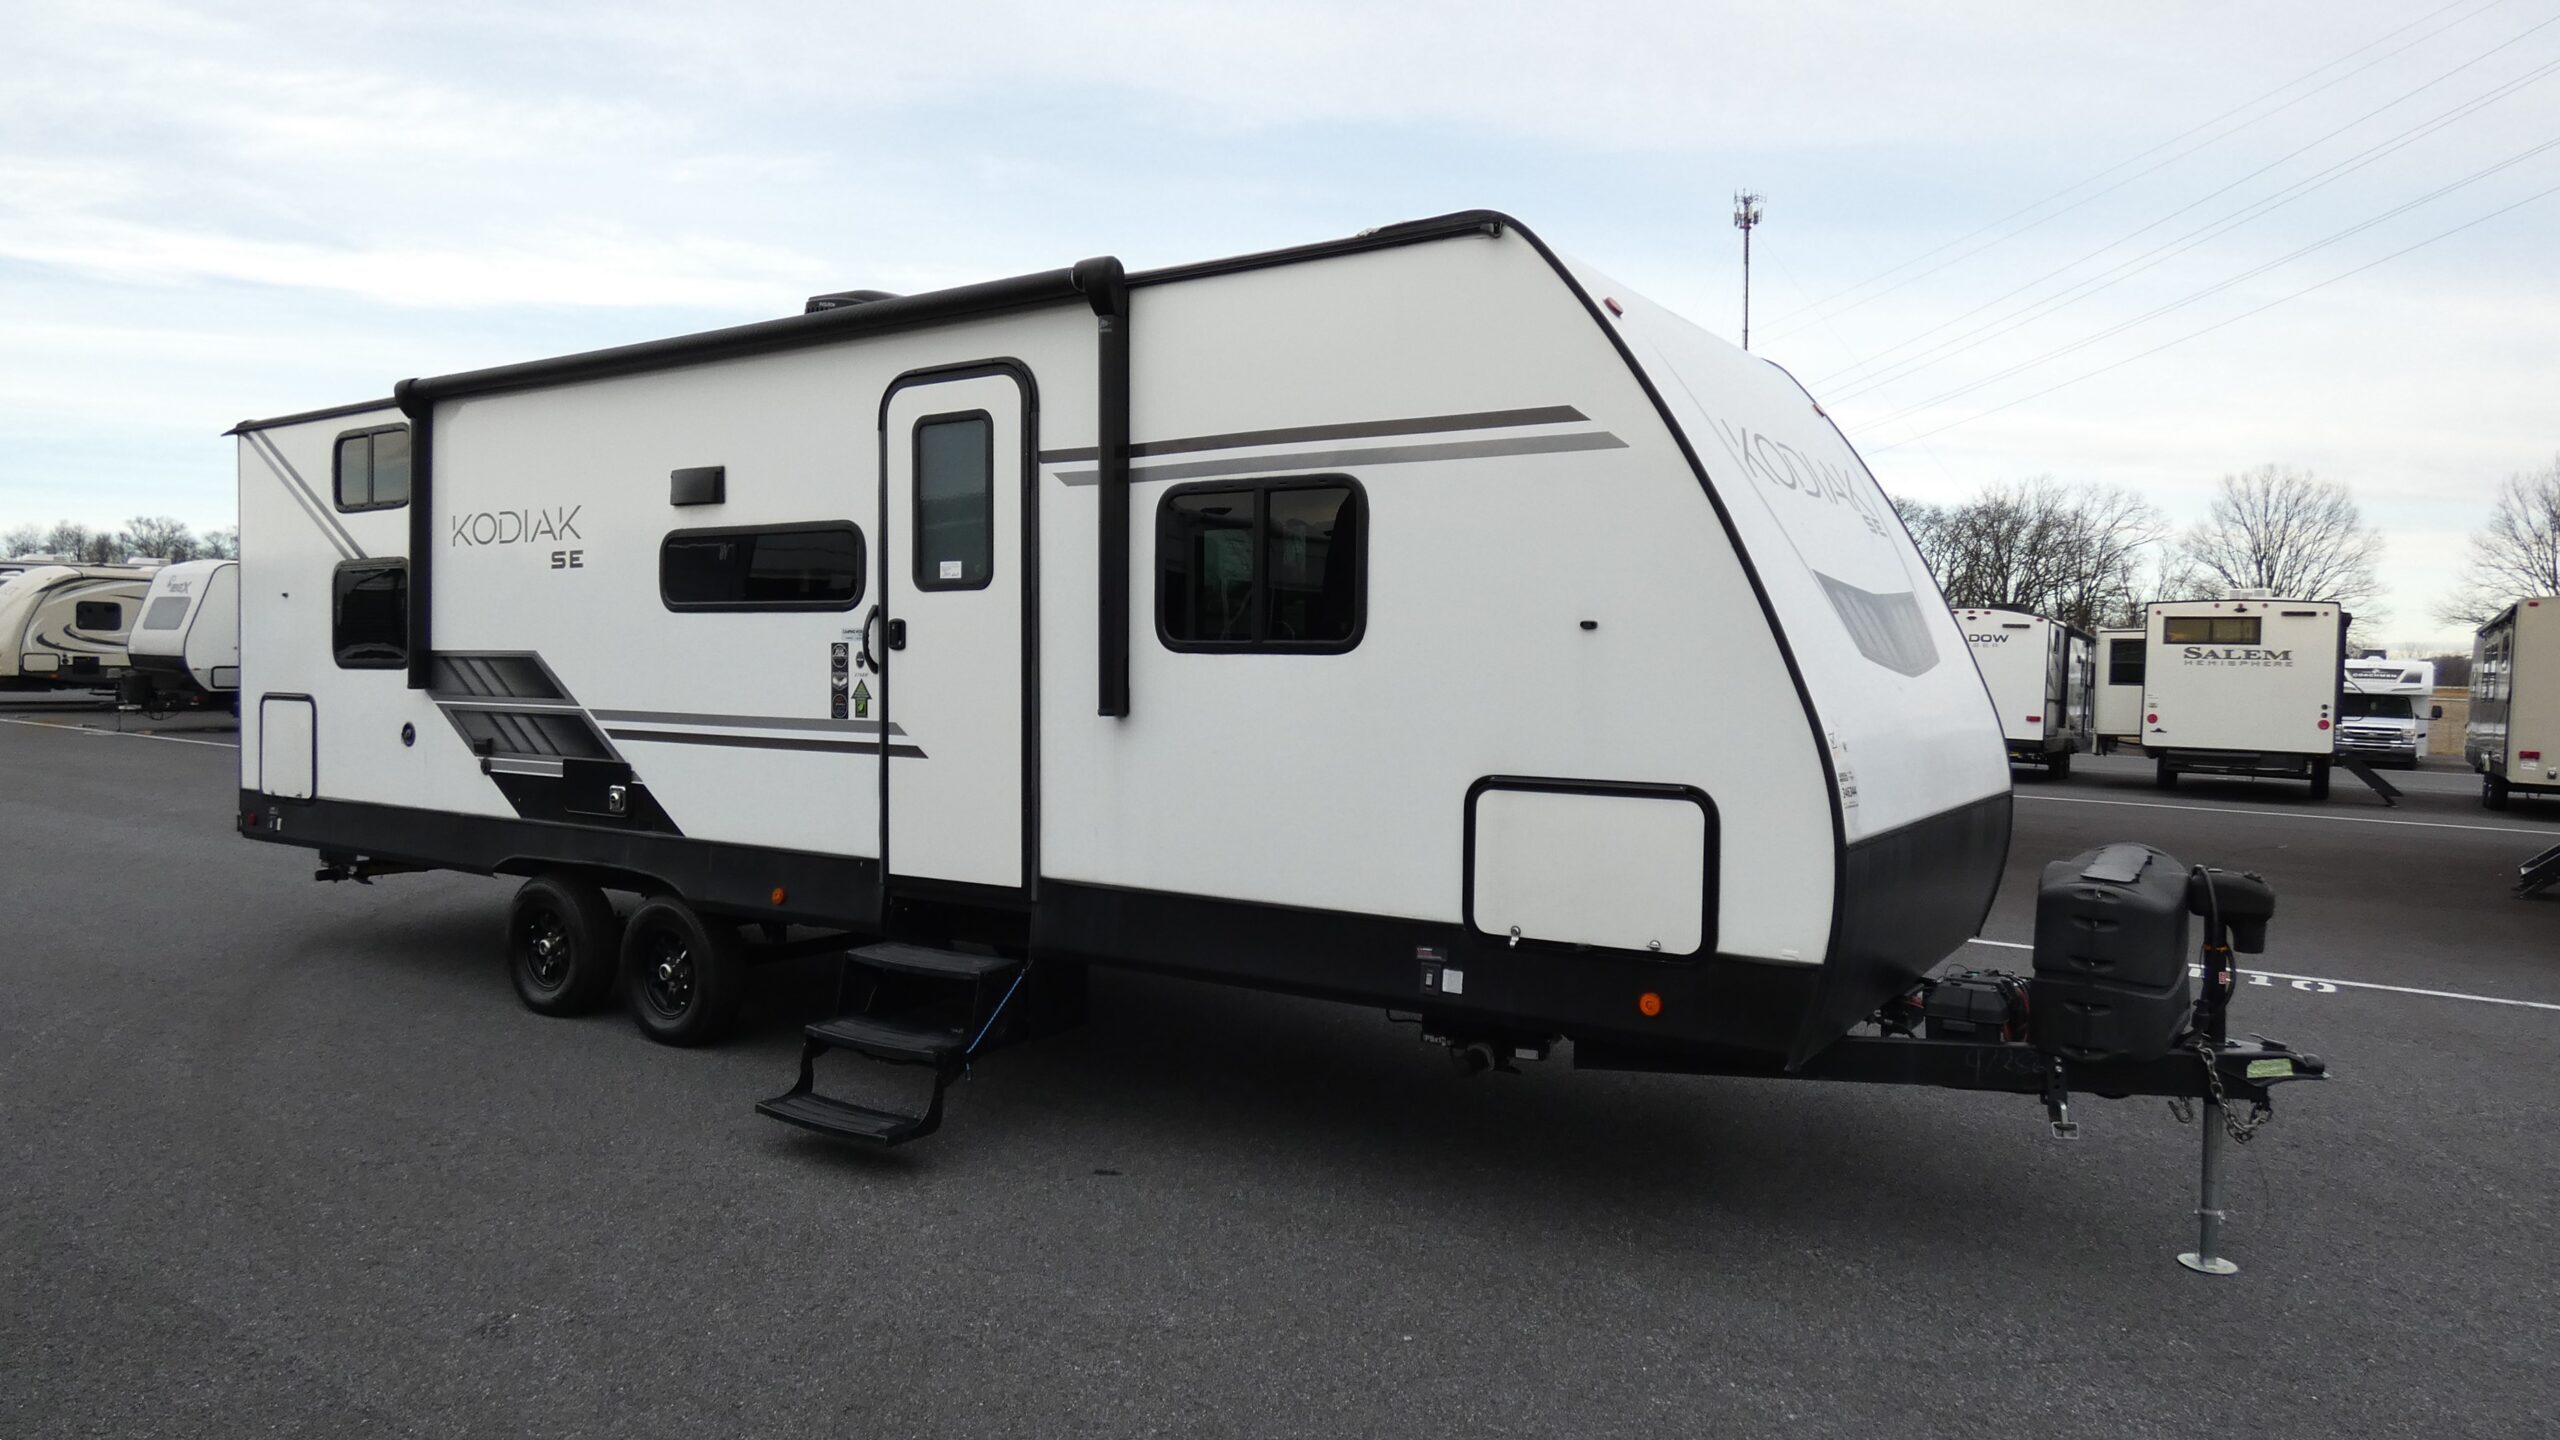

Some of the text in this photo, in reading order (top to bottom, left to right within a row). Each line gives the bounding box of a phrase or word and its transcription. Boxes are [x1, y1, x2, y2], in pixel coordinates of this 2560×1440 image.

[1721, 418, 1876, 517] KODIAK
[453, 505, 582, 547] KODIAK
[551, 550, 584, 570] SE
[1968, 634, 2009, 643] DOW
[2183, 647, 2293, 661] SALEM
